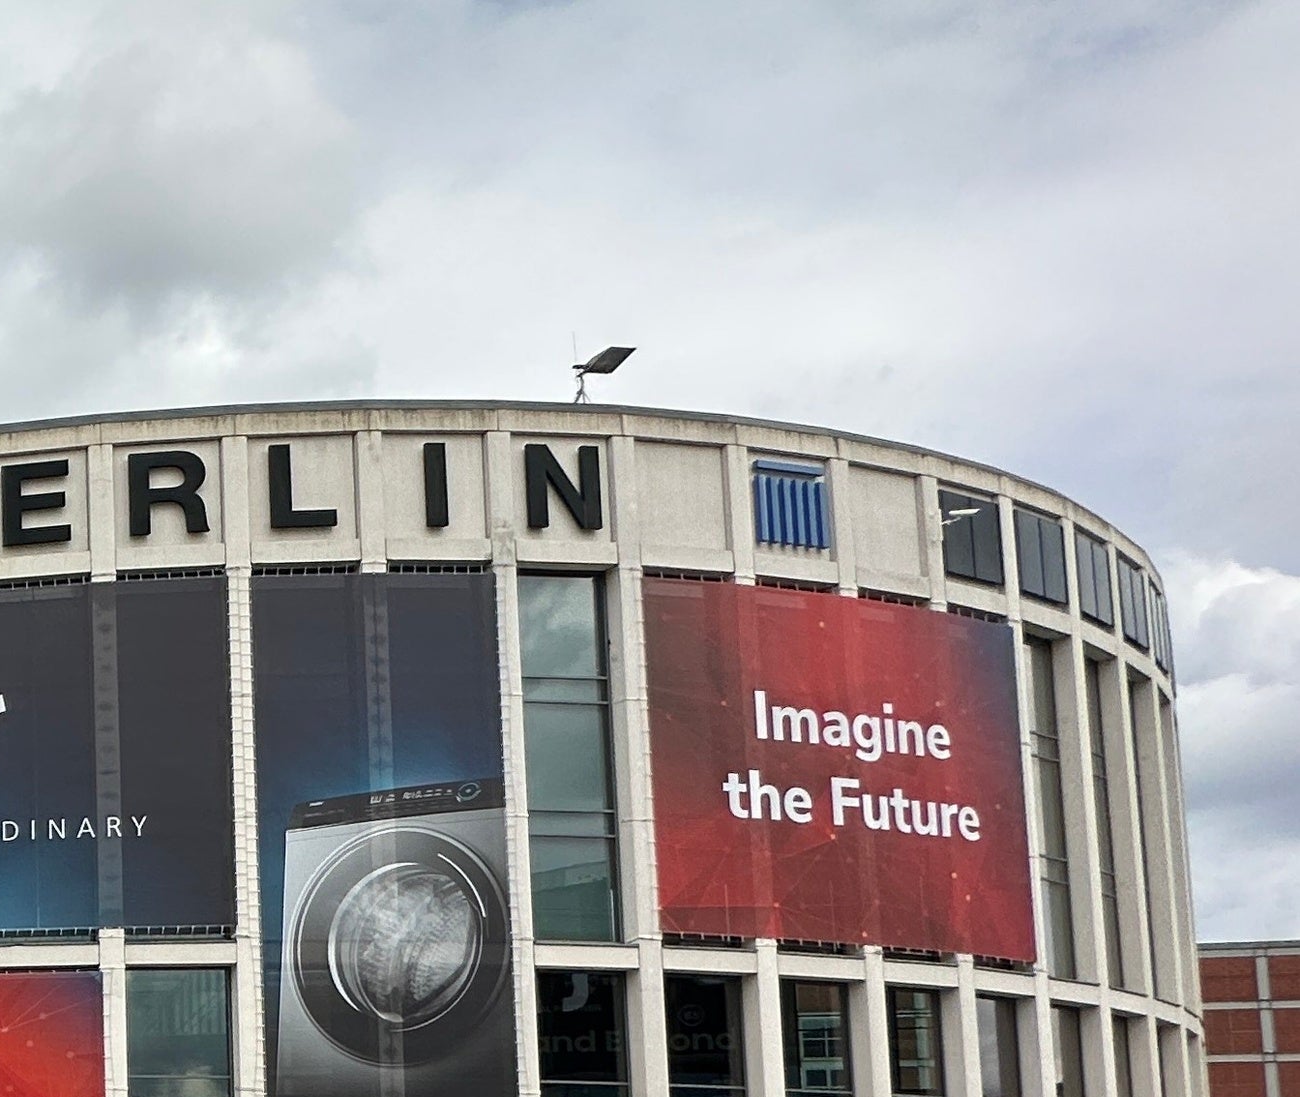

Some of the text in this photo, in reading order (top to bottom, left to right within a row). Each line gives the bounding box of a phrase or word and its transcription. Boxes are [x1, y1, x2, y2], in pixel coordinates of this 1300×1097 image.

[754, 690, 952, 762] Imagine
[722, 770, 981, 842] the Future
